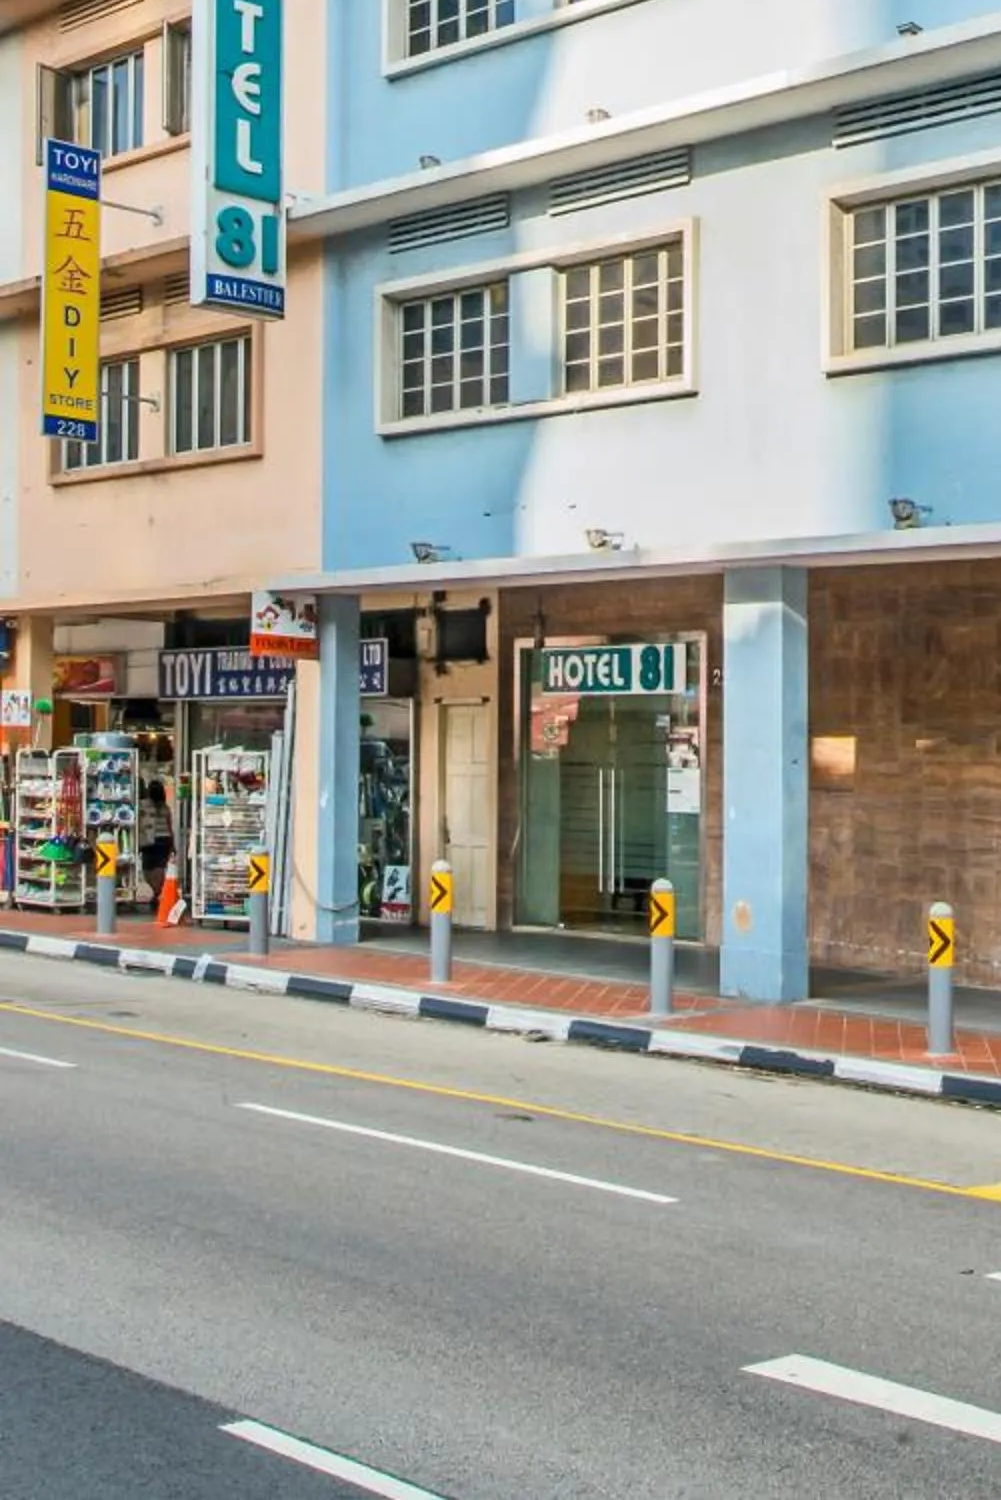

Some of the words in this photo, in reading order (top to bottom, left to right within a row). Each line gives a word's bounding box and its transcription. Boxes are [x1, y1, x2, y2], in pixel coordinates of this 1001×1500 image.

[52, 148, 97, 175] TOYI
[53, 208, 93, 296] 五金
[215, 206, 279, 275] 81
[63, 304, 81, 389] DIY
[50, 392, 93, 411] STORE
[57, 419, 87, 437] 228
[161, 653, 212, 697] TOYI
[363, 643, 381, 666] LTD
[549, 652, 625, 688] HOTEL
[639, 644, 674, 691] 81
